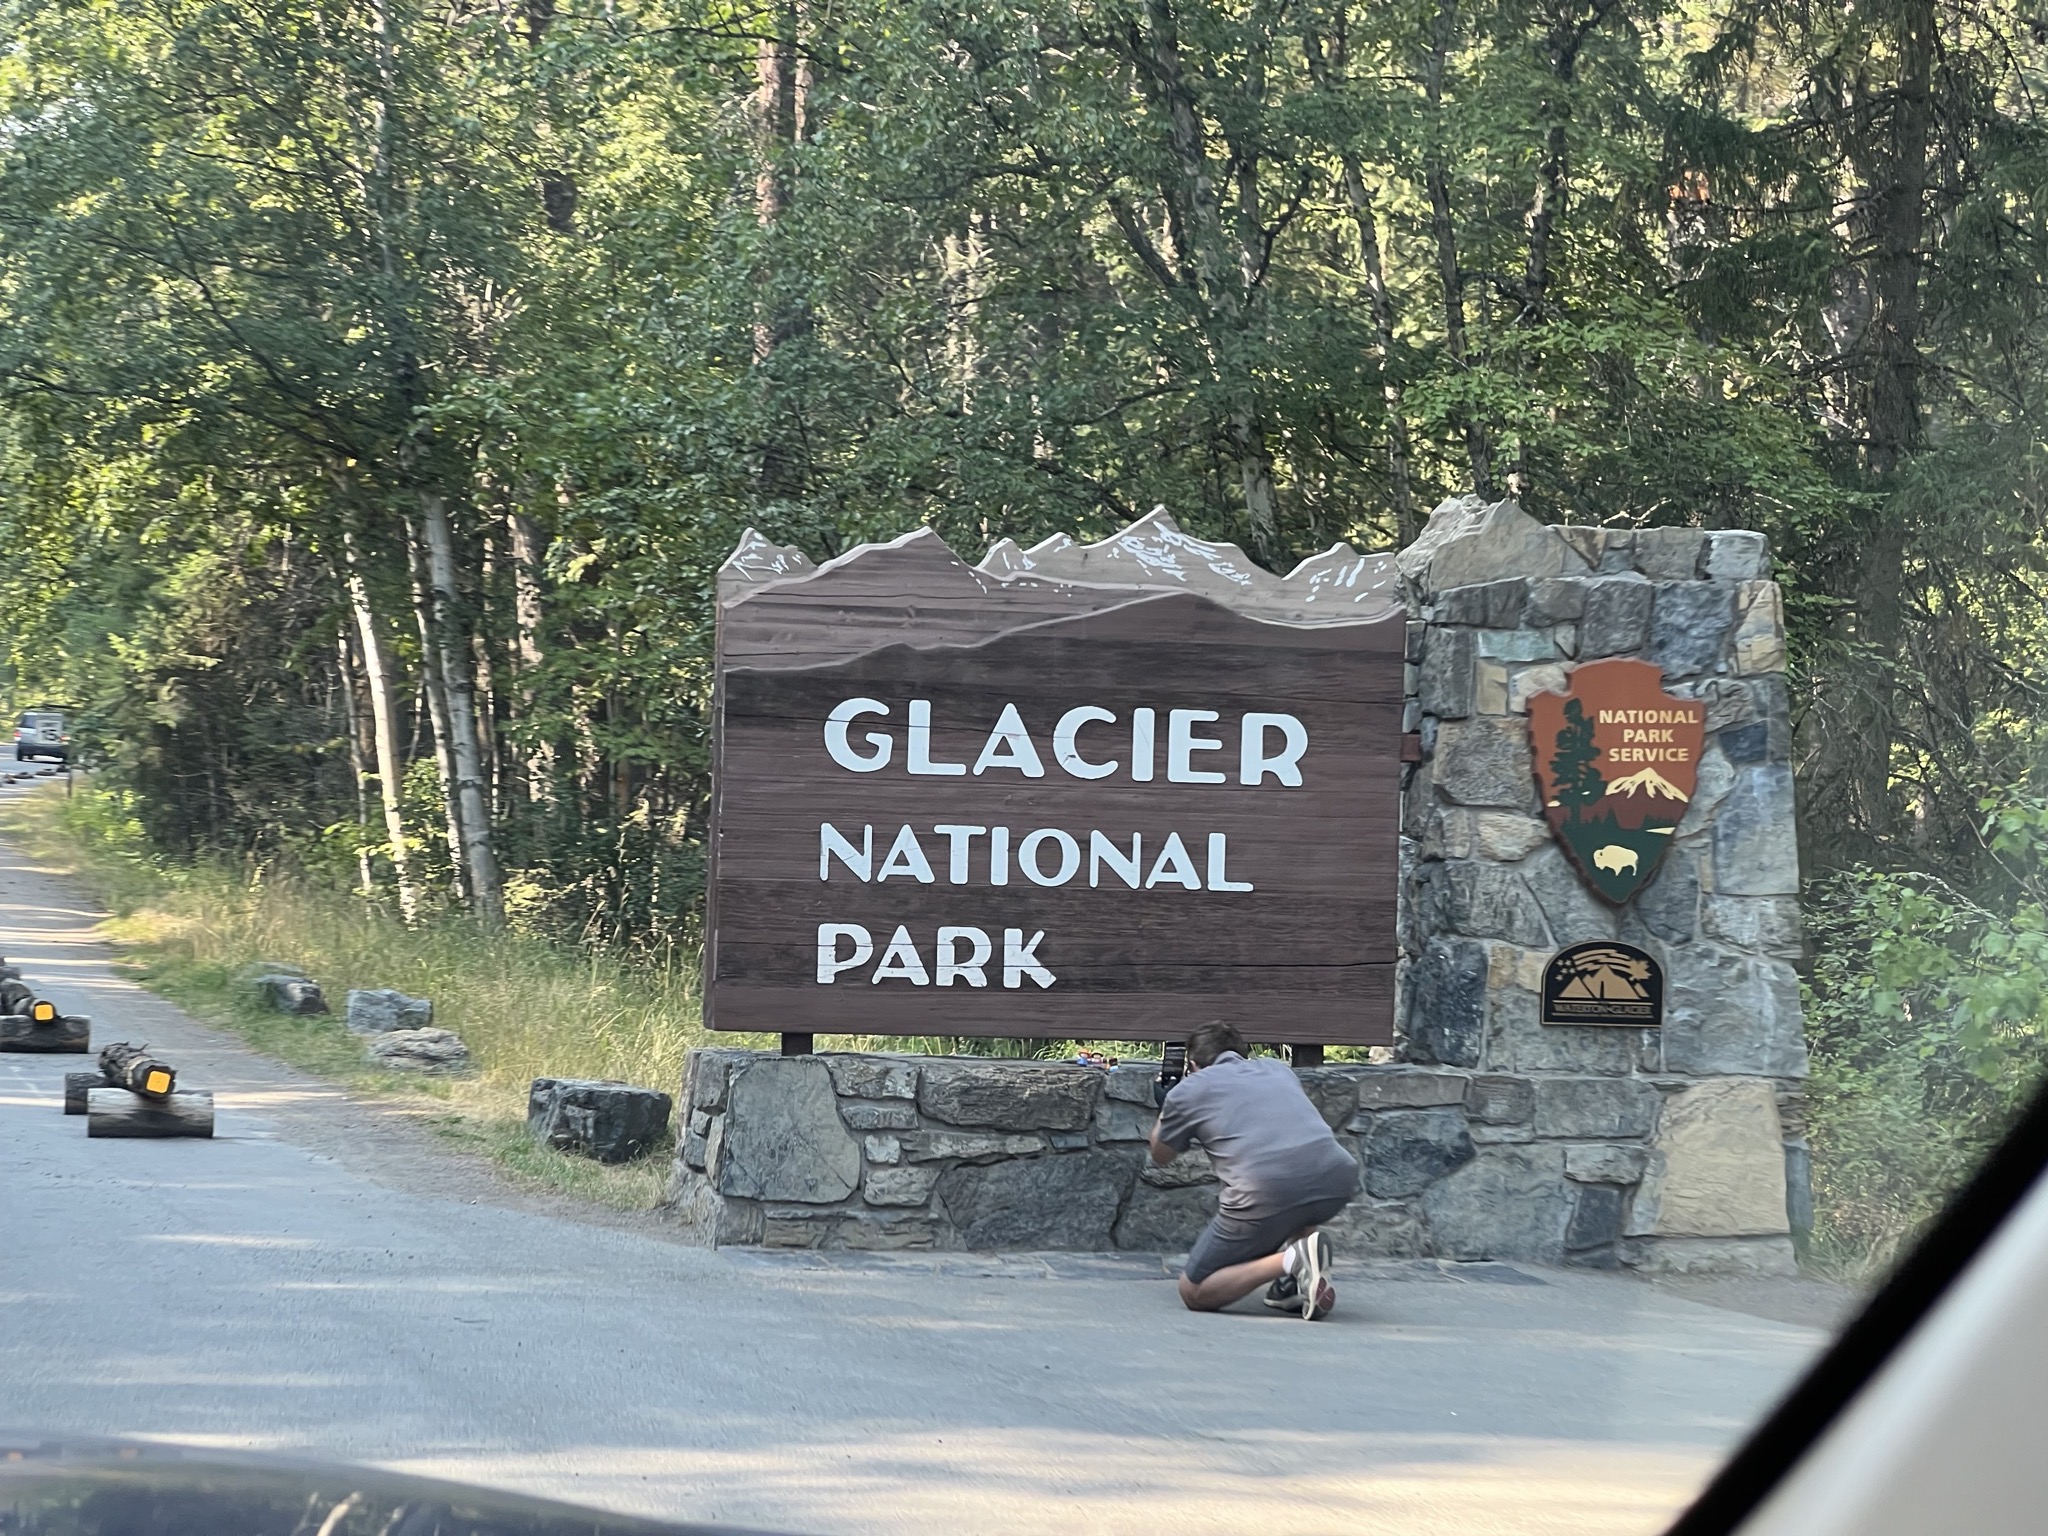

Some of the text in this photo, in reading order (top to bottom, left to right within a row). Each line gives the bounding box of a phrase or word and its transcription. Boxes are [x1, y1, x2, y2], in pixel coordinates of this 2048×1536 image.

[1599, 709, 1699, 724] NATIONAL
[1623, 728, 1674, 743] PARK
[824, 697, 1309, 787] GLACIER
[1609, 747, 1689, 762] SERVICE
[819, 822, 1254, 892] NATIONAL
[816, 923, 1057, 989] PARK
